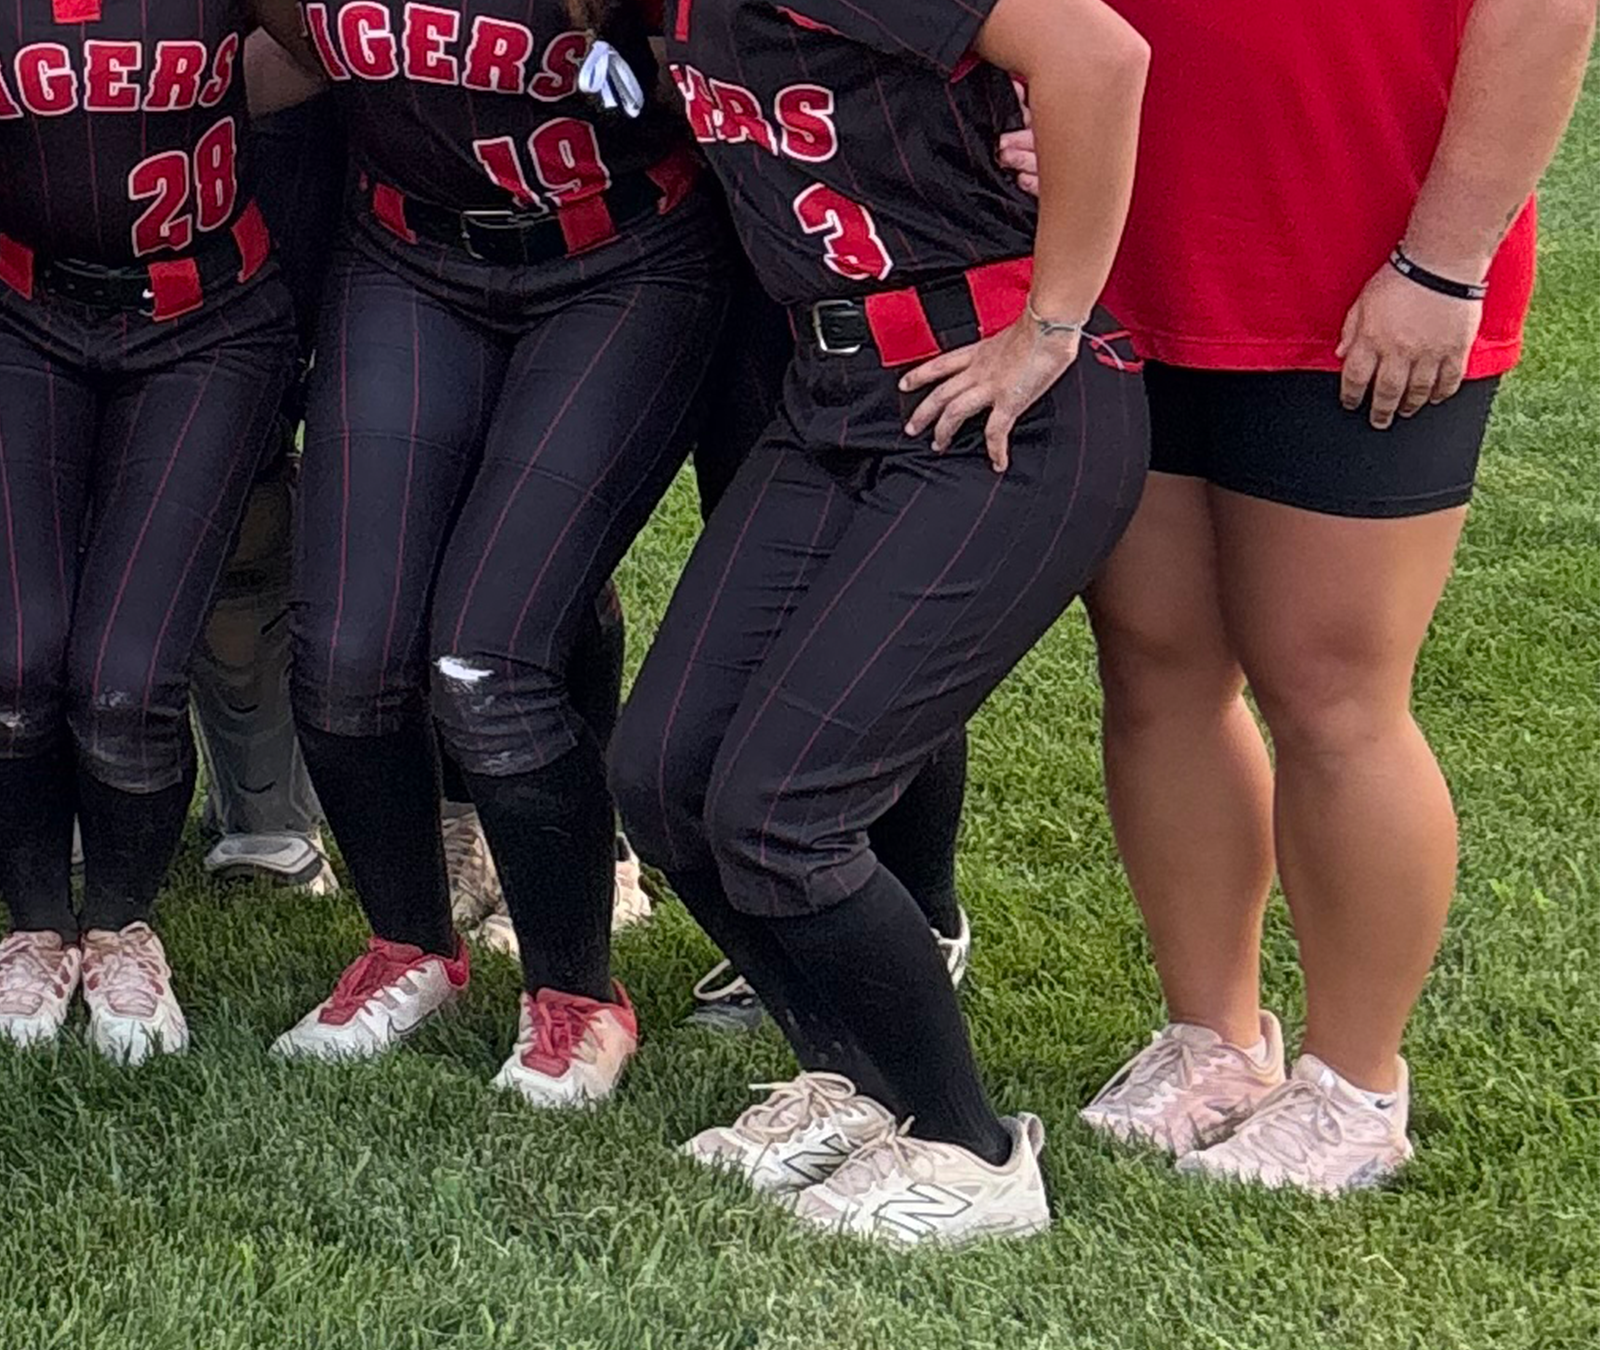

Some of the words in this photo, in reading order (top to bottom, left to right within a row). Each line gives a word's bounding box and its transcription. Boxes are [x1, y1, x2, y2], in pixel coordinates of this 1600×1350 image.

[128, 116, 237, 258] 28
[472, 116, 613, 212] 19
[793, 182, 894, 281] 3
